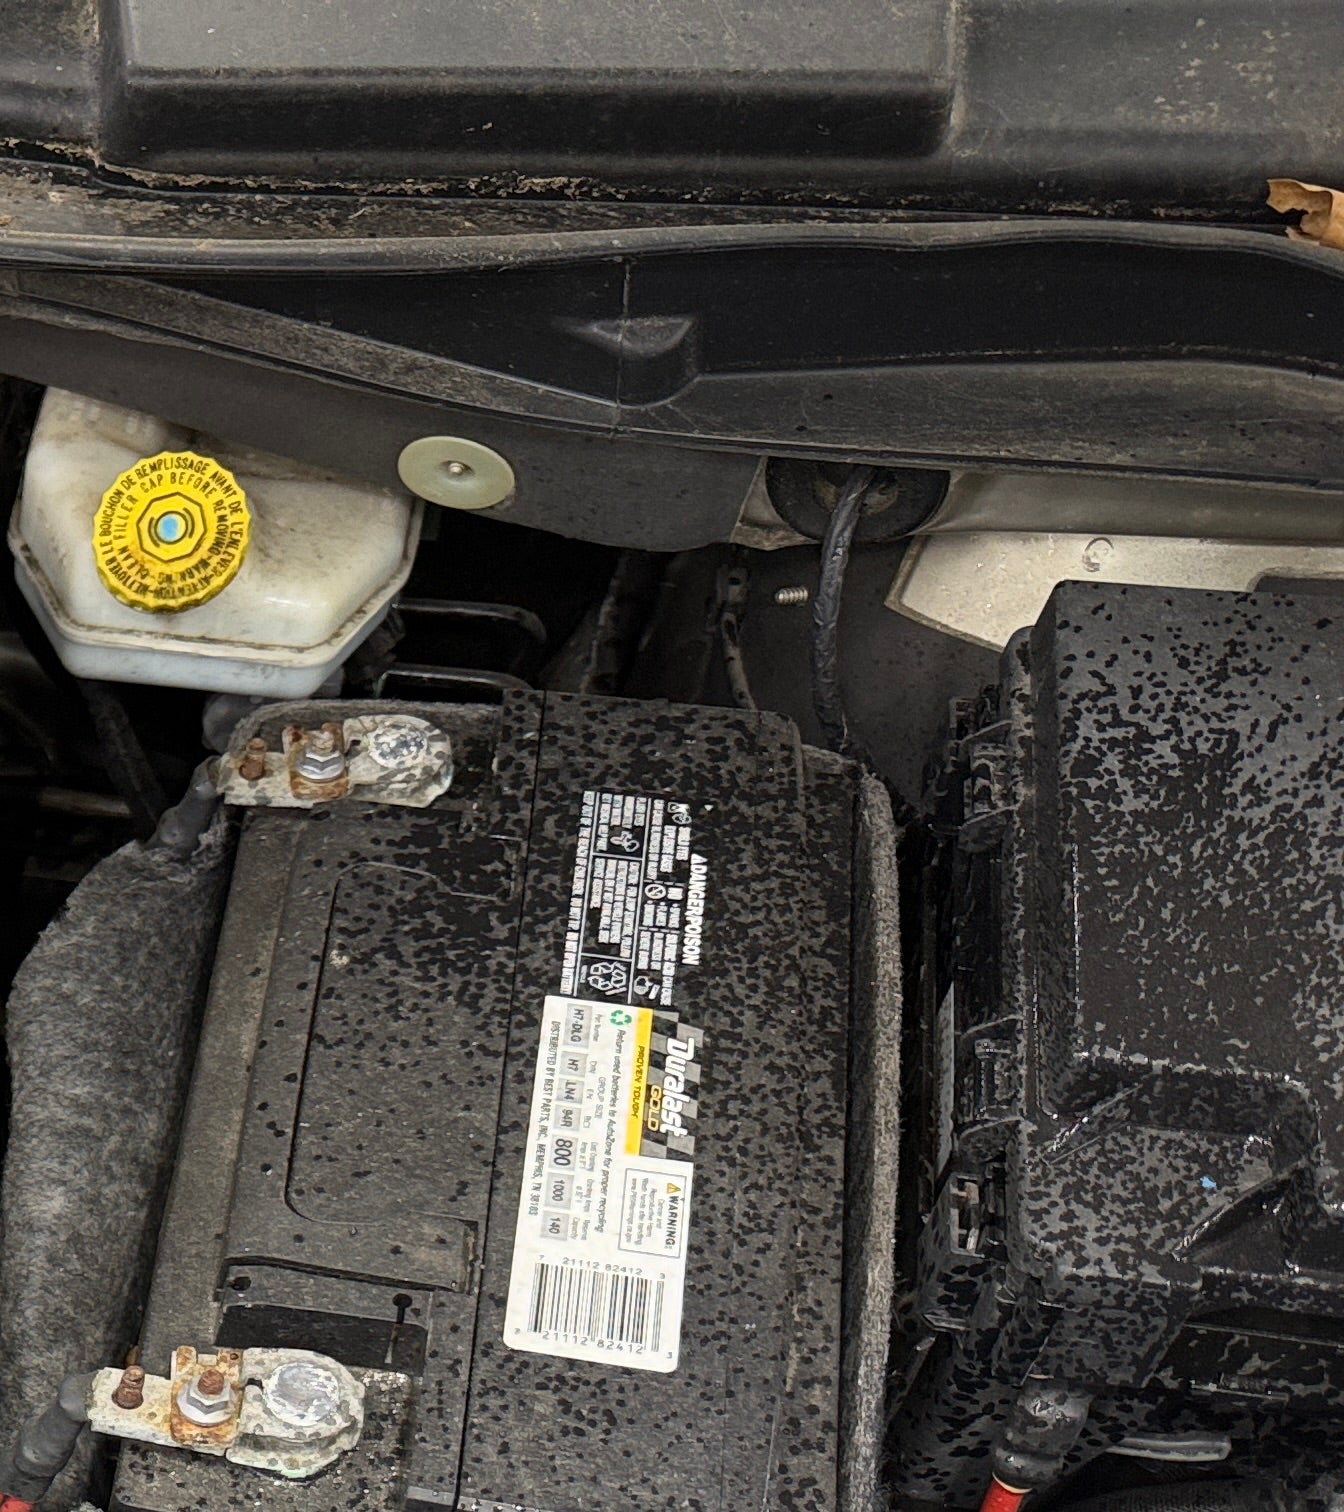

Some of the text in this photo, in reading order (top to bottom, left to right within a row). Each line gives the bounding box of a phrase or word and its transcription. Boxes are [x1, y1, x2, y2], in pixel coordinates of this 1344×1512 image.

[99, 488, 125, 537] BOUCHON
[120, 474, 137, 490] DE
[135, 456, 210, 480] REMPLISSAGE
[209, 471, 238, 498] AVANT
[228, 500, 243, 515] DE
[113, 495, 138, 541] FILLER
[140, 473, 163, 493] CAP
[170, 471, 217, 498] BEFORE
[545, 1067, 555, 1076] BY
[566, 1058, 579, 1071] H7
[612, 1055, 623, 1074] used
[633, 1045, 646, 1083] PROVEN
[542, 1078, 554, 1096] BEST
[656, 1036, 697, 1137] Duralast
[559, 1108, 574, 1127] 94R
[646, 1084, 663, 1132] GOLD
[552, 1137, 573, 1166] 800
[603, 1157, 612, 1168] for
[551, 1179, 566, 1202] 1000
[547, 1216, 561, 1234] 140
[561, 1256, 599, 1270] 21112
[604, 1262, 642, 1276] 82412
[541, 1328, 588, 1347] 21112
[596, 1337, 643, 1355] 82412
